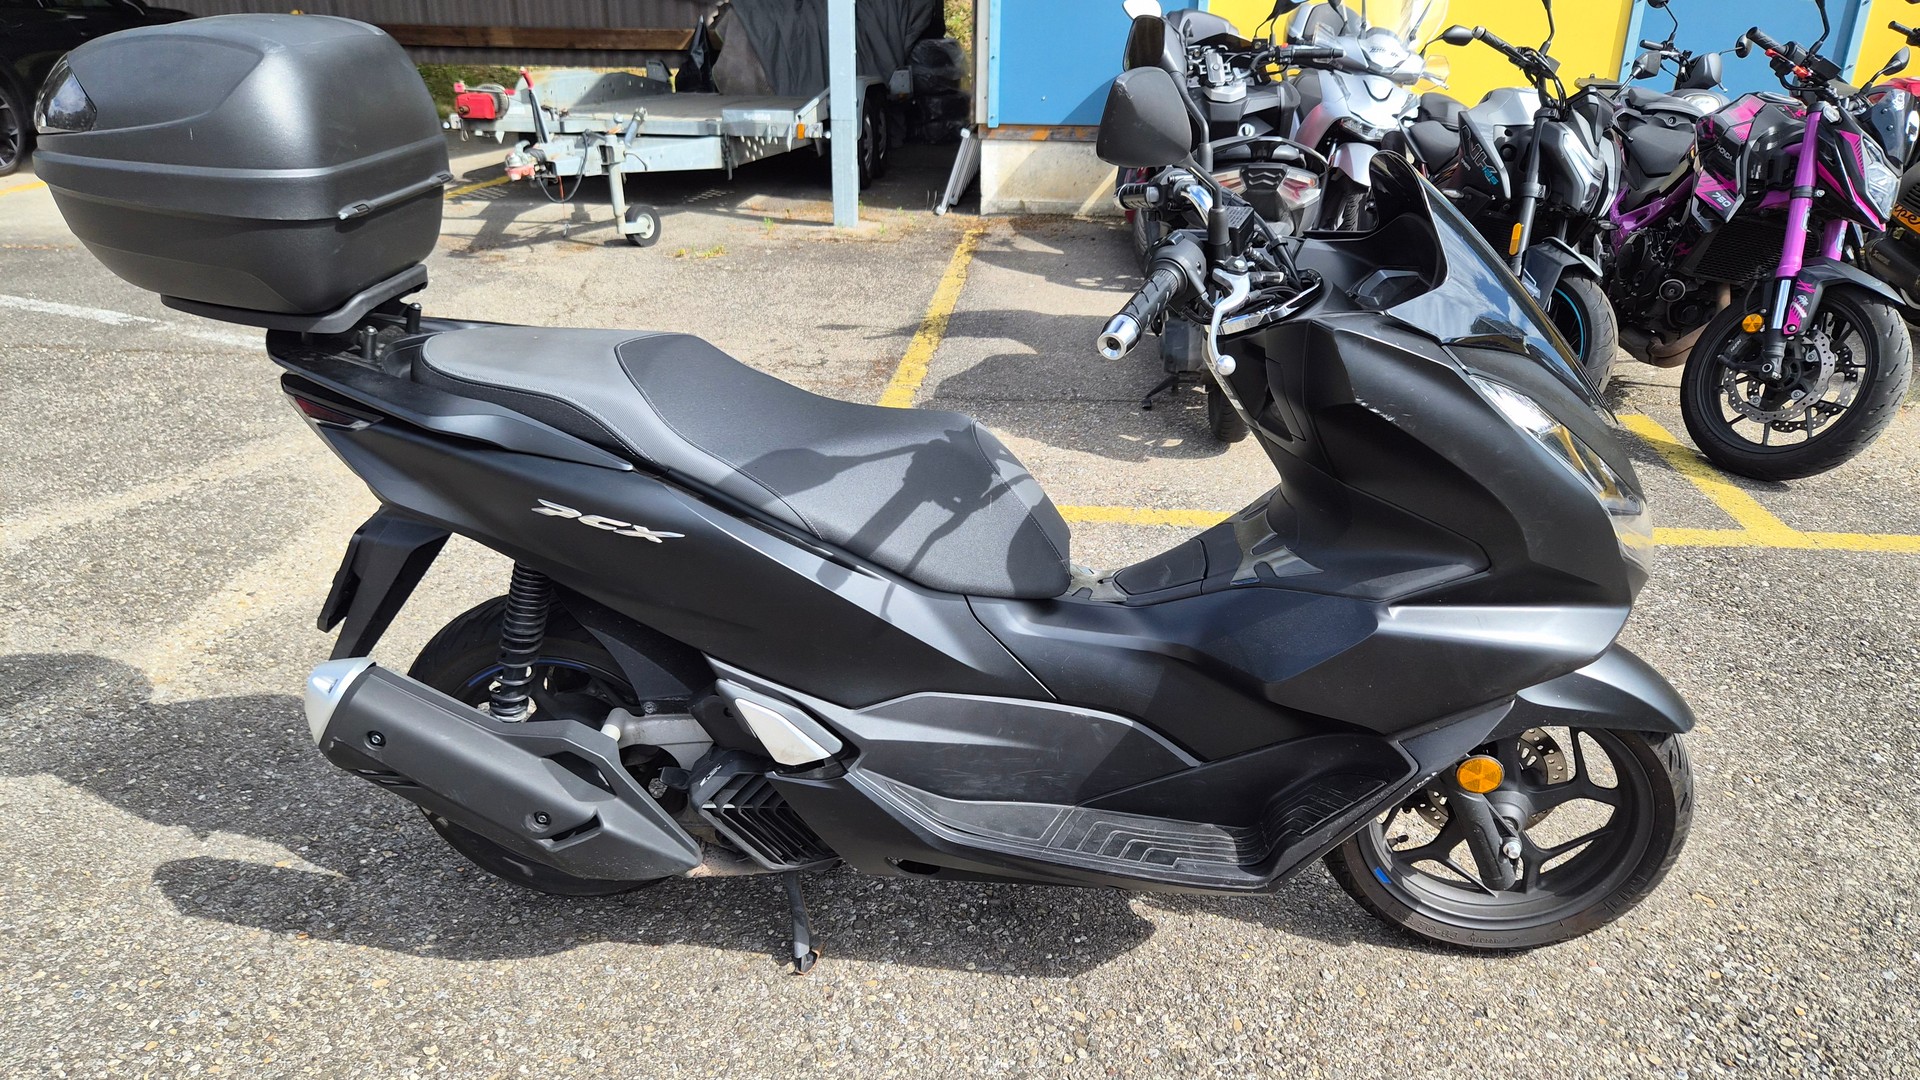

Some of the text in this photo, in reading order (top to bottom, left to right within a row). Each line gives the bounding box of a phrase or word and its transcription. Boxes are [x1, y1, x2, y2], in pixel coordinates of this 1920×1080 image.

[1716, 143, 1733, 161] HONDA
[1711, 191, 1732, 208] 750
[530, 498, 686, 544] PCX
